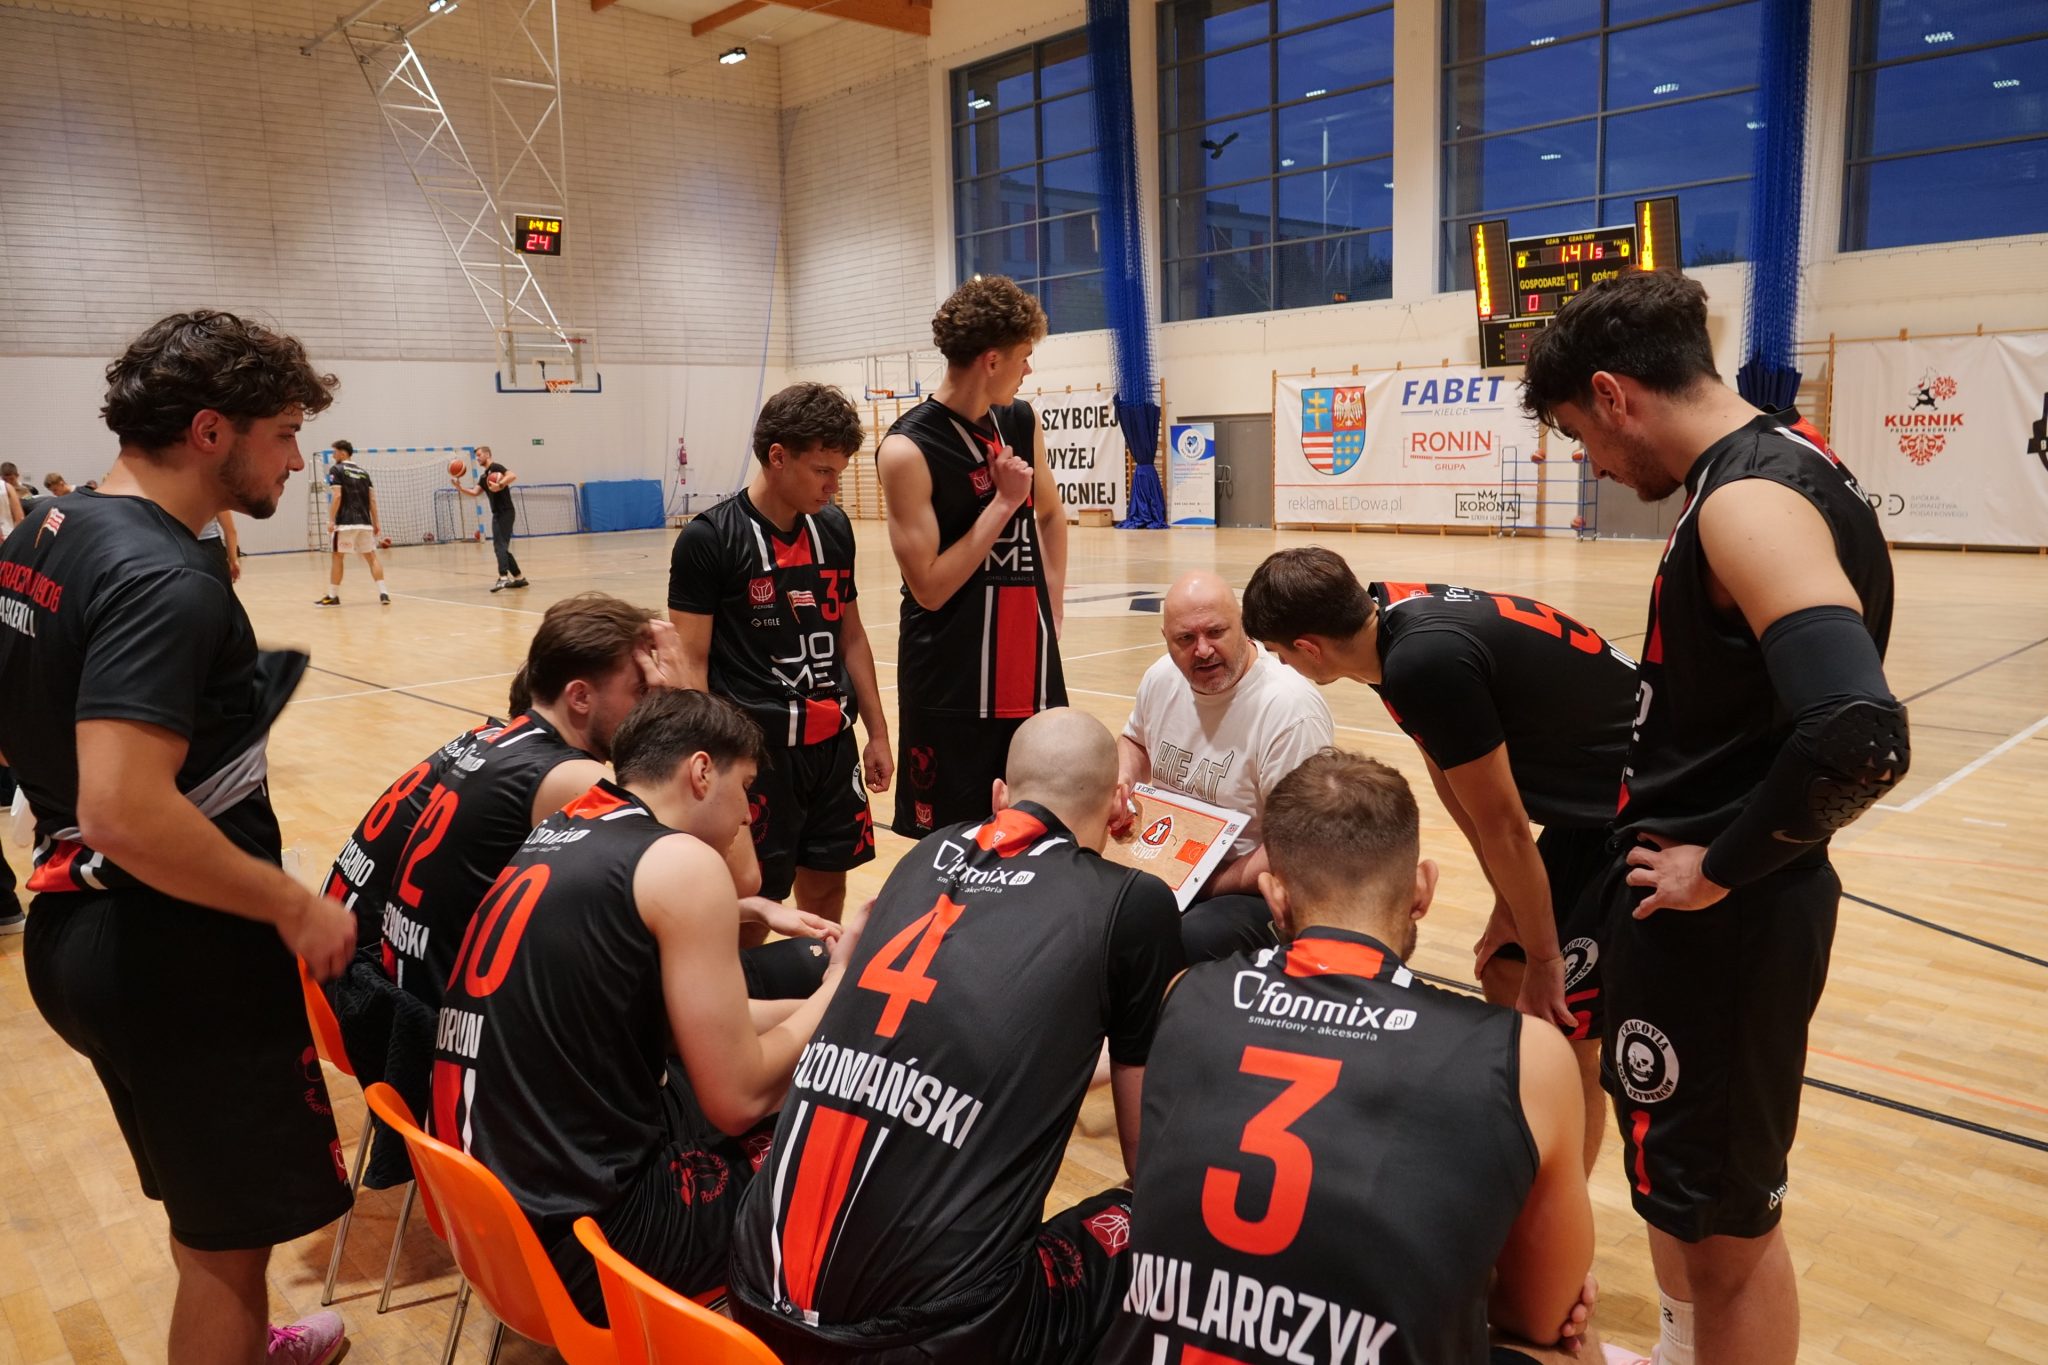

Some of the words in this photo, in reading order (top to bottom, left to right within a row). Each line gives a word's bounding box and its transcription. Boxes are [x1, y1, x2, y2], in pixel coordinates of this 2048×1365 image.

[526, 233, 551, 250] 24
[1519, 275, 1566, 290] GOSPODARZE
[1528, 294, 1539, 311] 0
[1401, 376, 1505, 406] FABET
[1041, 405, 1119, 431] SZYBCIEJ
[1432, 407, 1470, 417] KIELCE
[1884, 413, 1964, 427] KURNIK
[1410, 430, 1492, 452] RONIN
[1434, 463, 1466, 471] GRUPA
[1056, 482, 1116, 505] OCNIEJ
[1288, 495, 1402, 514] reklamaLEDowa.pl
[1459, 501, 1517, 512] KORONA
[763, 617, 781, 627] EGLE
[1152, 740, 1235, 804] HEAT
[362, 761, 432, 842] 8
[857, 893, 967, 1039] 4
[1248, 1015, 1308, 1033] smartfony
[1317, 1025, 1378, 1041] akcesoria
[1620, 1020, 1670, 1052] CRACOVIA
[1628, 1076, 1675, 1101] SZYDERCÓW
[1200, 1045, 1344, 1257] 3
